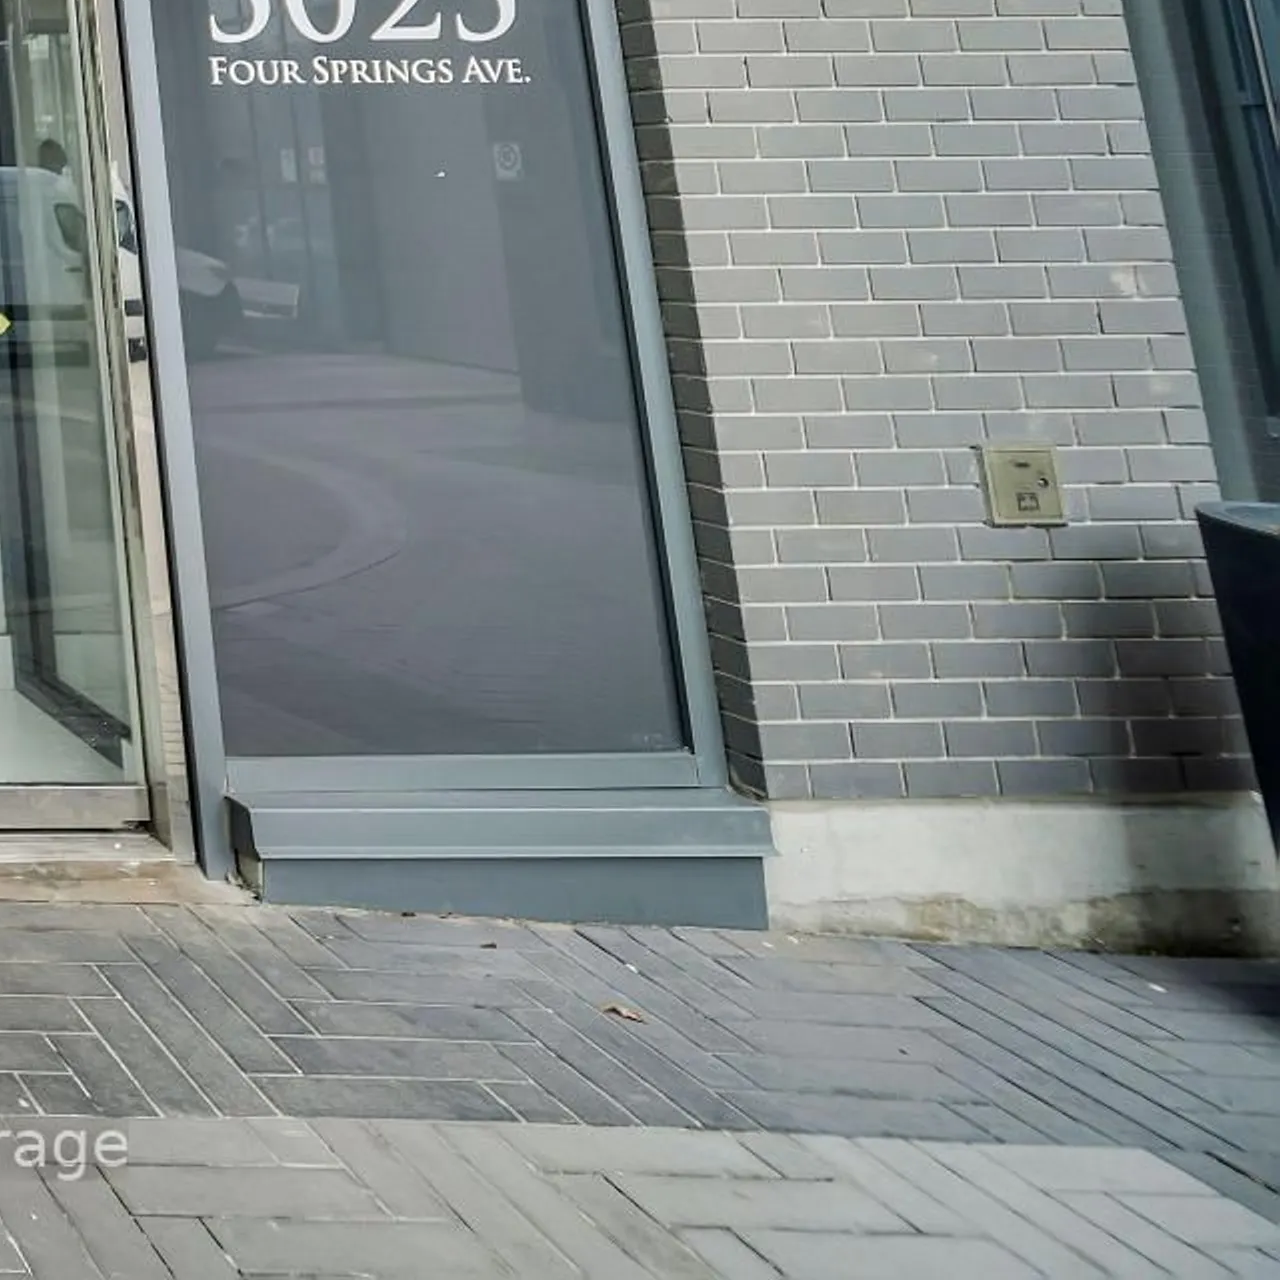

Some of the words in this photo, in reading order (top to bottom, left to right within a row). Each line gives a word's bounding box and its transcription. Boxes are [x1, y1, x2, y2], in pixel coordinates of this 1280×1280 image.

[208, 56, 307, 86] FOUR
[312, 56, 454, 84] SPRINGS
[461, 56, 532, 84] AVE.
